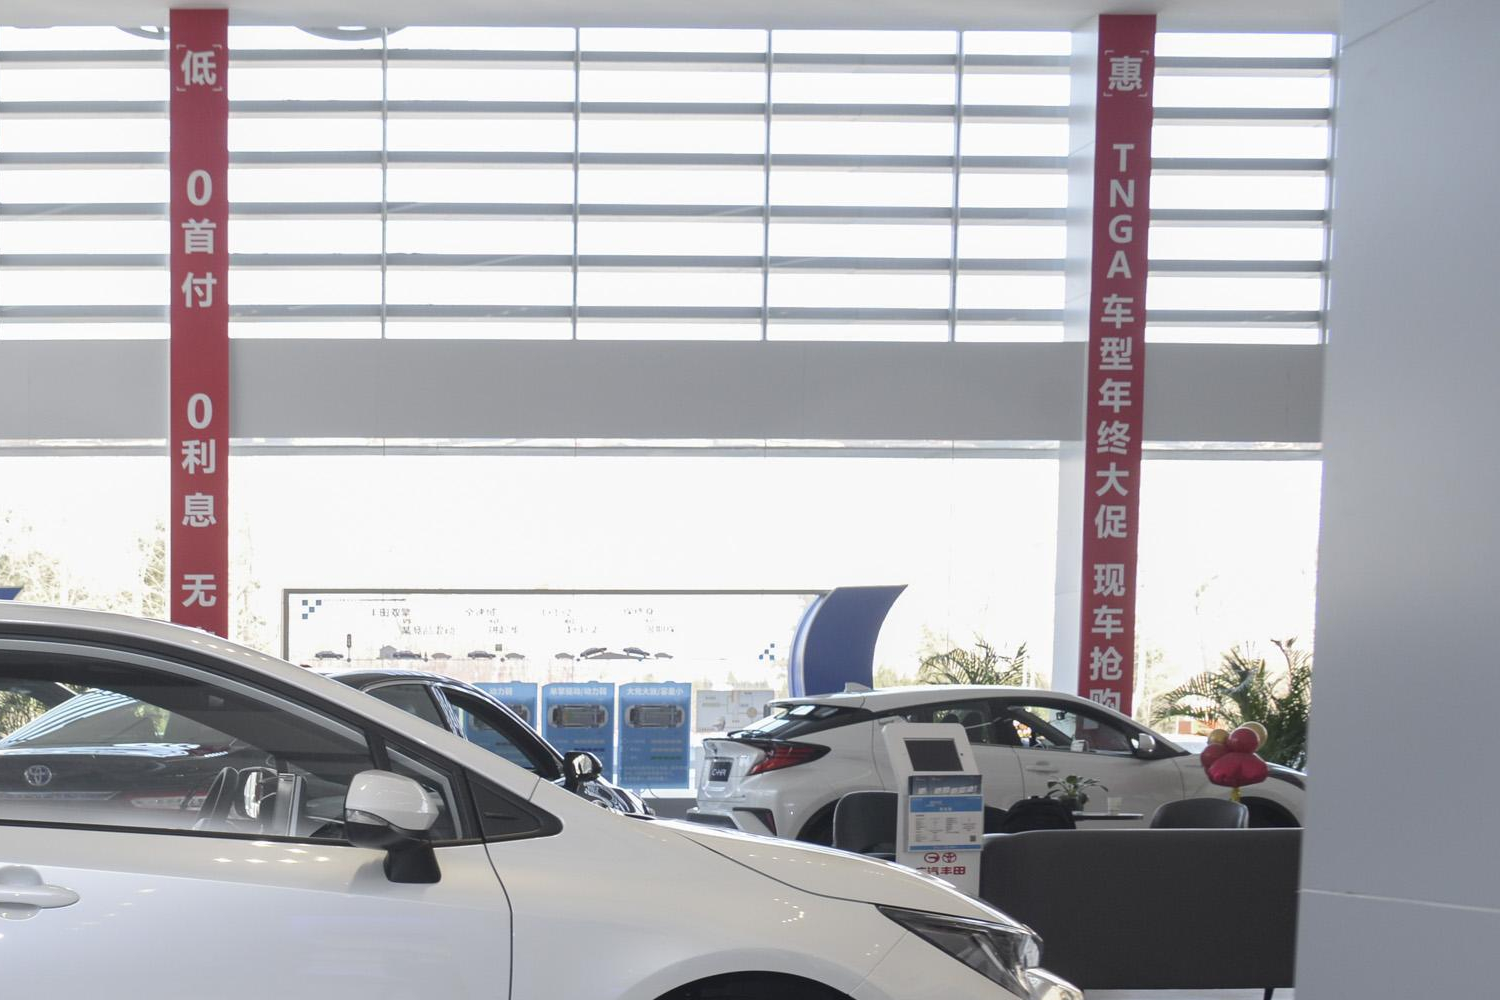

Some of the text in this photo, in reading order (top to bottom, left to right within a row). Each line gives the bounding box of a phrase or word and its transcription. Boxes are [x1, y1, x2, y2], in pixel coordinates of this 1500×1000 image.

[181, 50, 217, 85] 低
[1108, 56, 1143, 91] 惠
[181, 170, 217, 308] 0首付
[181, 393, 217, 527] 0利息
